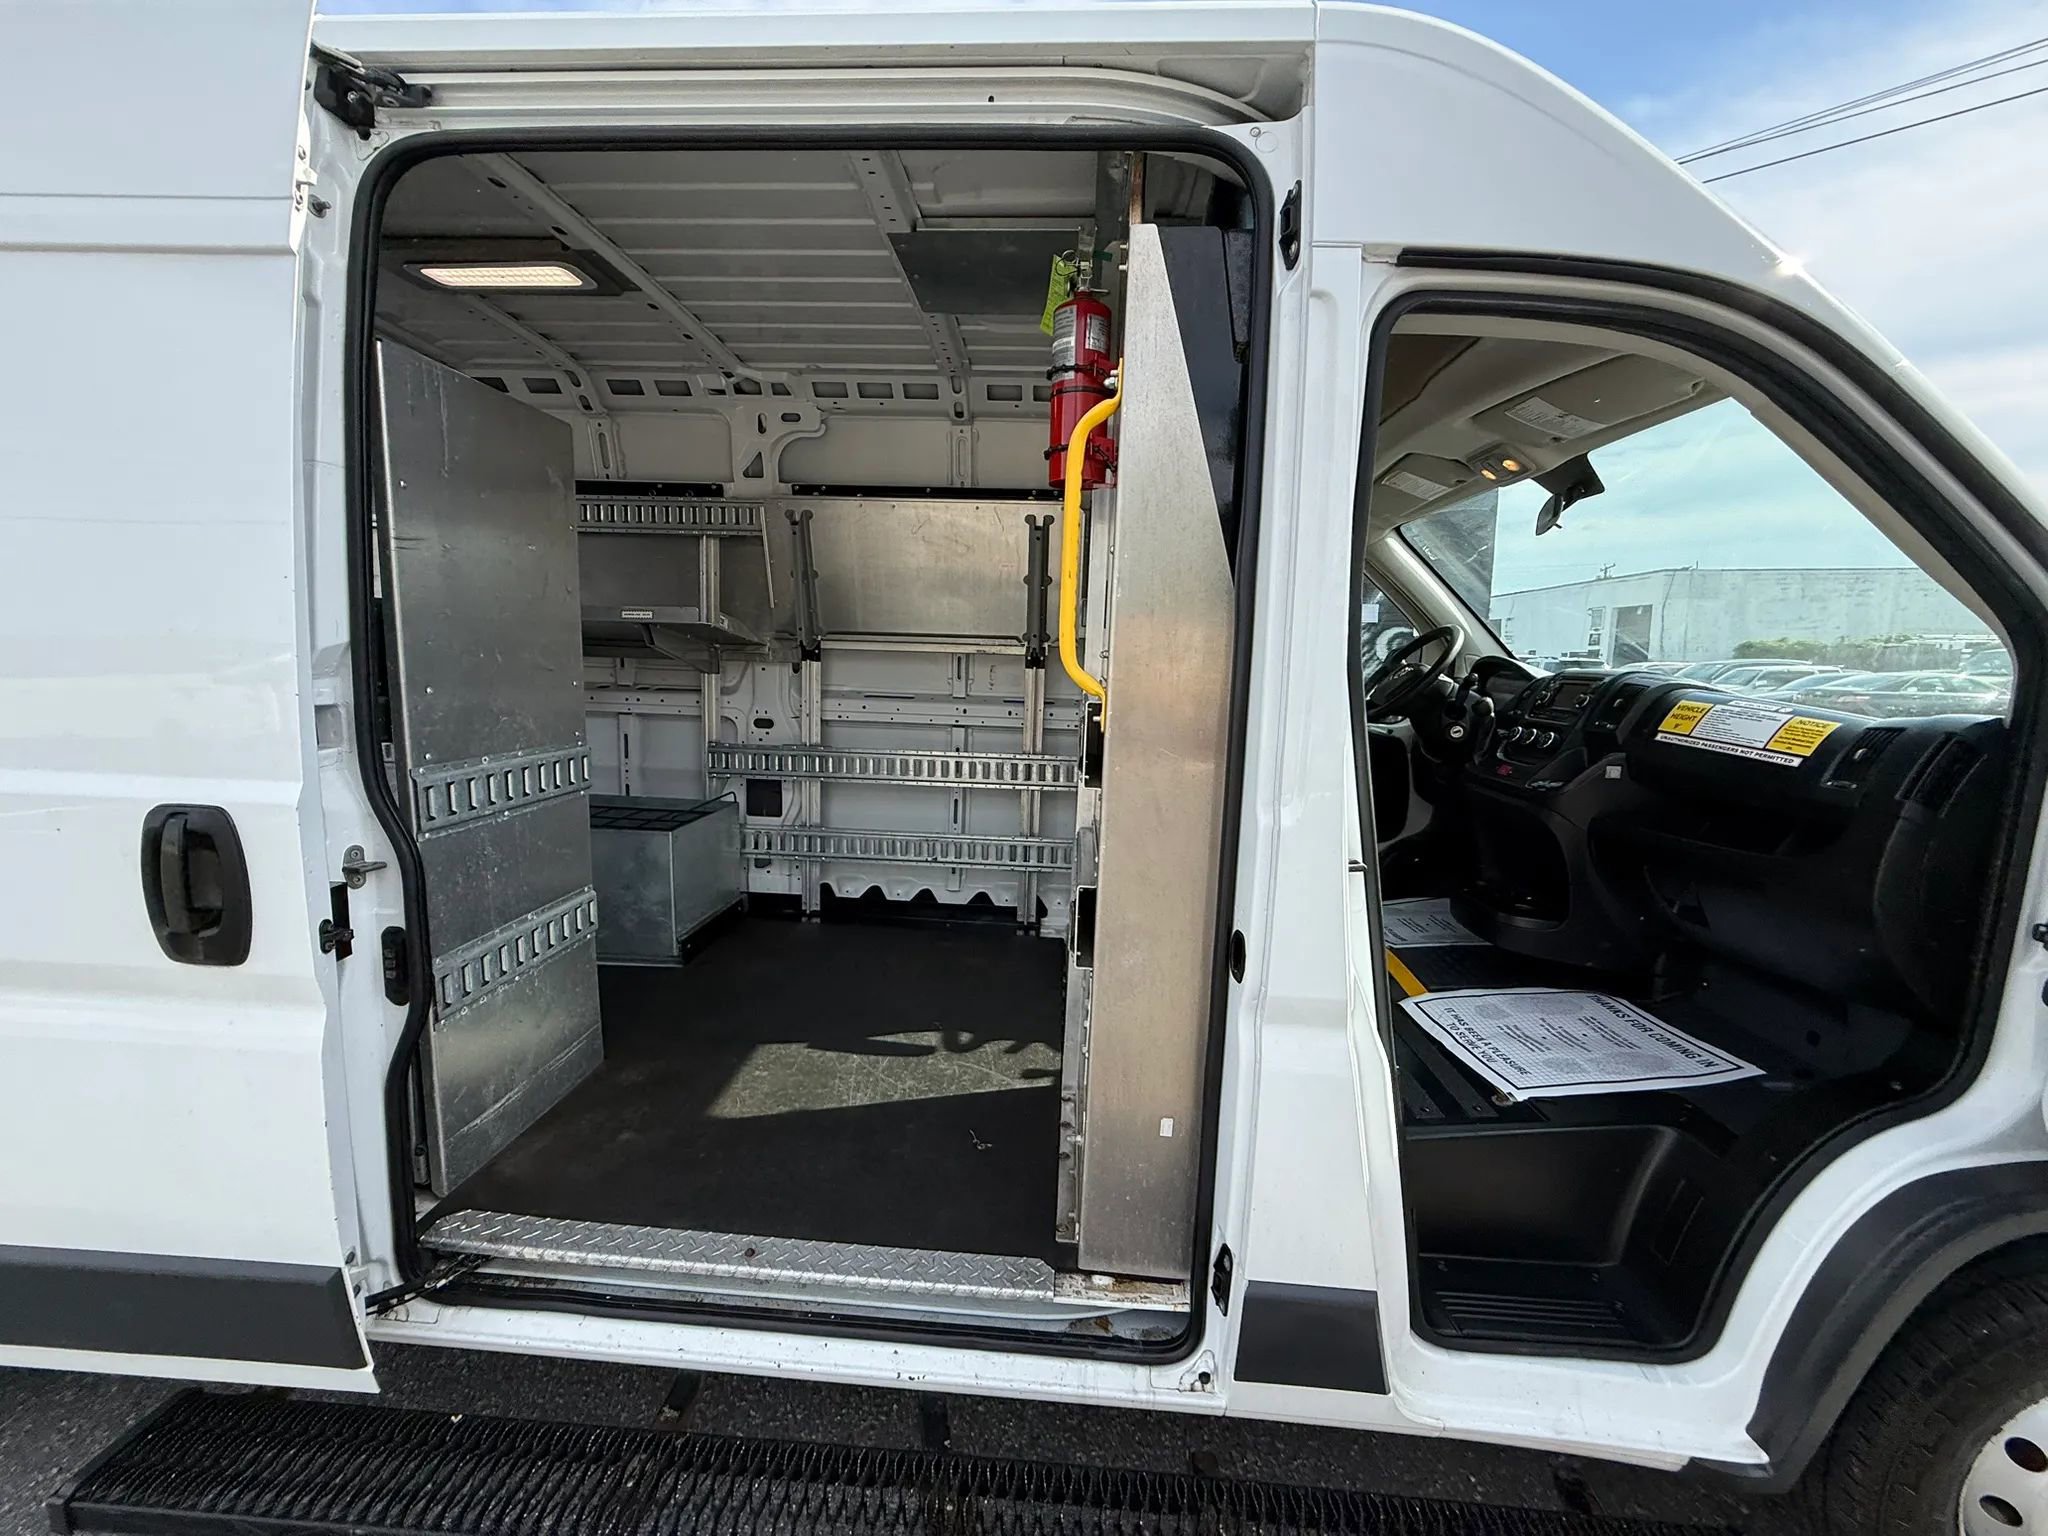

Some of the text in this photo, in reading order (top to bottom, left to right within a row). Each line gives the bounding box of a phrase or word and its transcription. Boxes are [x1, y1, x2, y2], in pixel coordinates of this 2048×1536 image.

[1670, 713, 1698, 722] HEIGHT
[1676, 704, 1707, 713] VEHICLE
[1796, 719, 1830, 728] NOTICE
[1660, 734, 1794, 764] UNAUTHORIZED PASSENGERS NOT PERMITTED
[1446, 1022, 1460, 1031] TO
[1455, 1030, 1481, 1050] SERVE
[1450, 1012, 1469, 1027] HAS
[1464, 1026, 1487, 1042] BEEN
[1487, 1046, 1532, 1075] PLEASURE
[1586, 994, 1630, 1019] THANKS
[1624, 1018, 1652, 1033] FOR
[1647, 1030, 1699, 1059] COMING
[1695, 1057, 1720, 1068] IN
